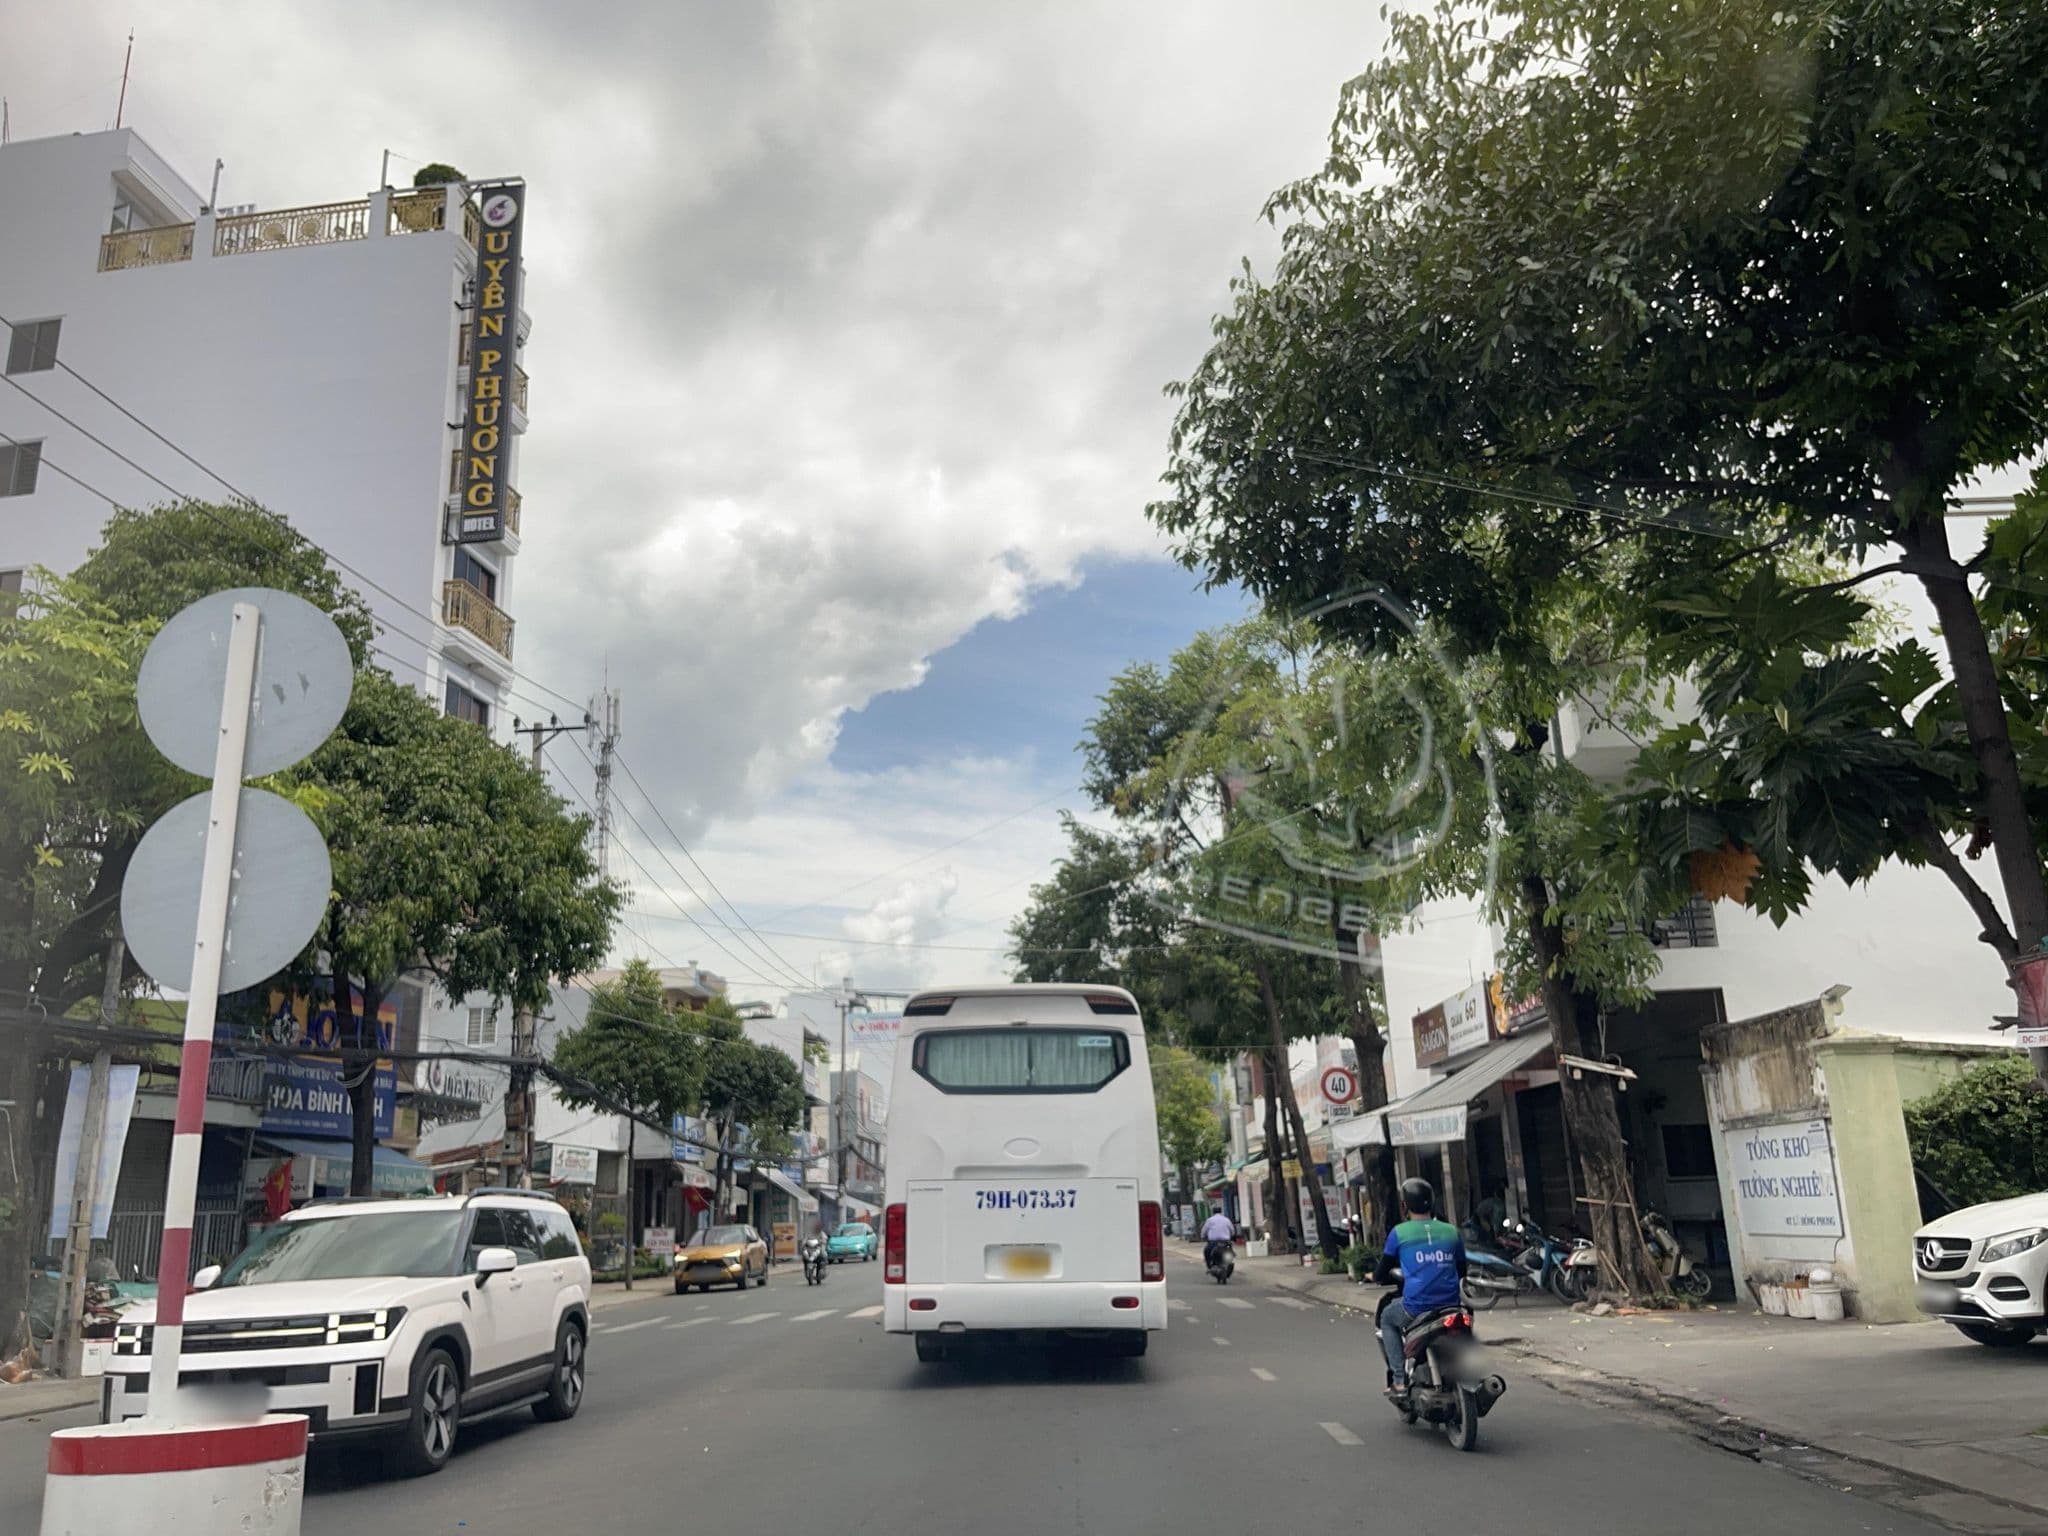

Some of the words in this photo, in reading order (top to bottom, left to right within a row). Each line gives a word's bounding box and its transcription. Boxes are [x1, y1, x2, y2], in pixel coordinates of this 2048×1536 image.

[479, 231, 512, 338] UYÊN
[467, 350, 502, 507] PHƯƠNG
[464, 516, 496, 532] HOTEL
[1465, 998, 1477, 1020] 667
[1331, 1077, 1346, 1093] 40
[307, 1085, 344, 1114] BÌNH
[1746, 1129, 1779, 1161] TỔNG
[1782, 1136, 1810, 1159] KHO
[975, 1189, 1077, 1209] 79H-073.37
